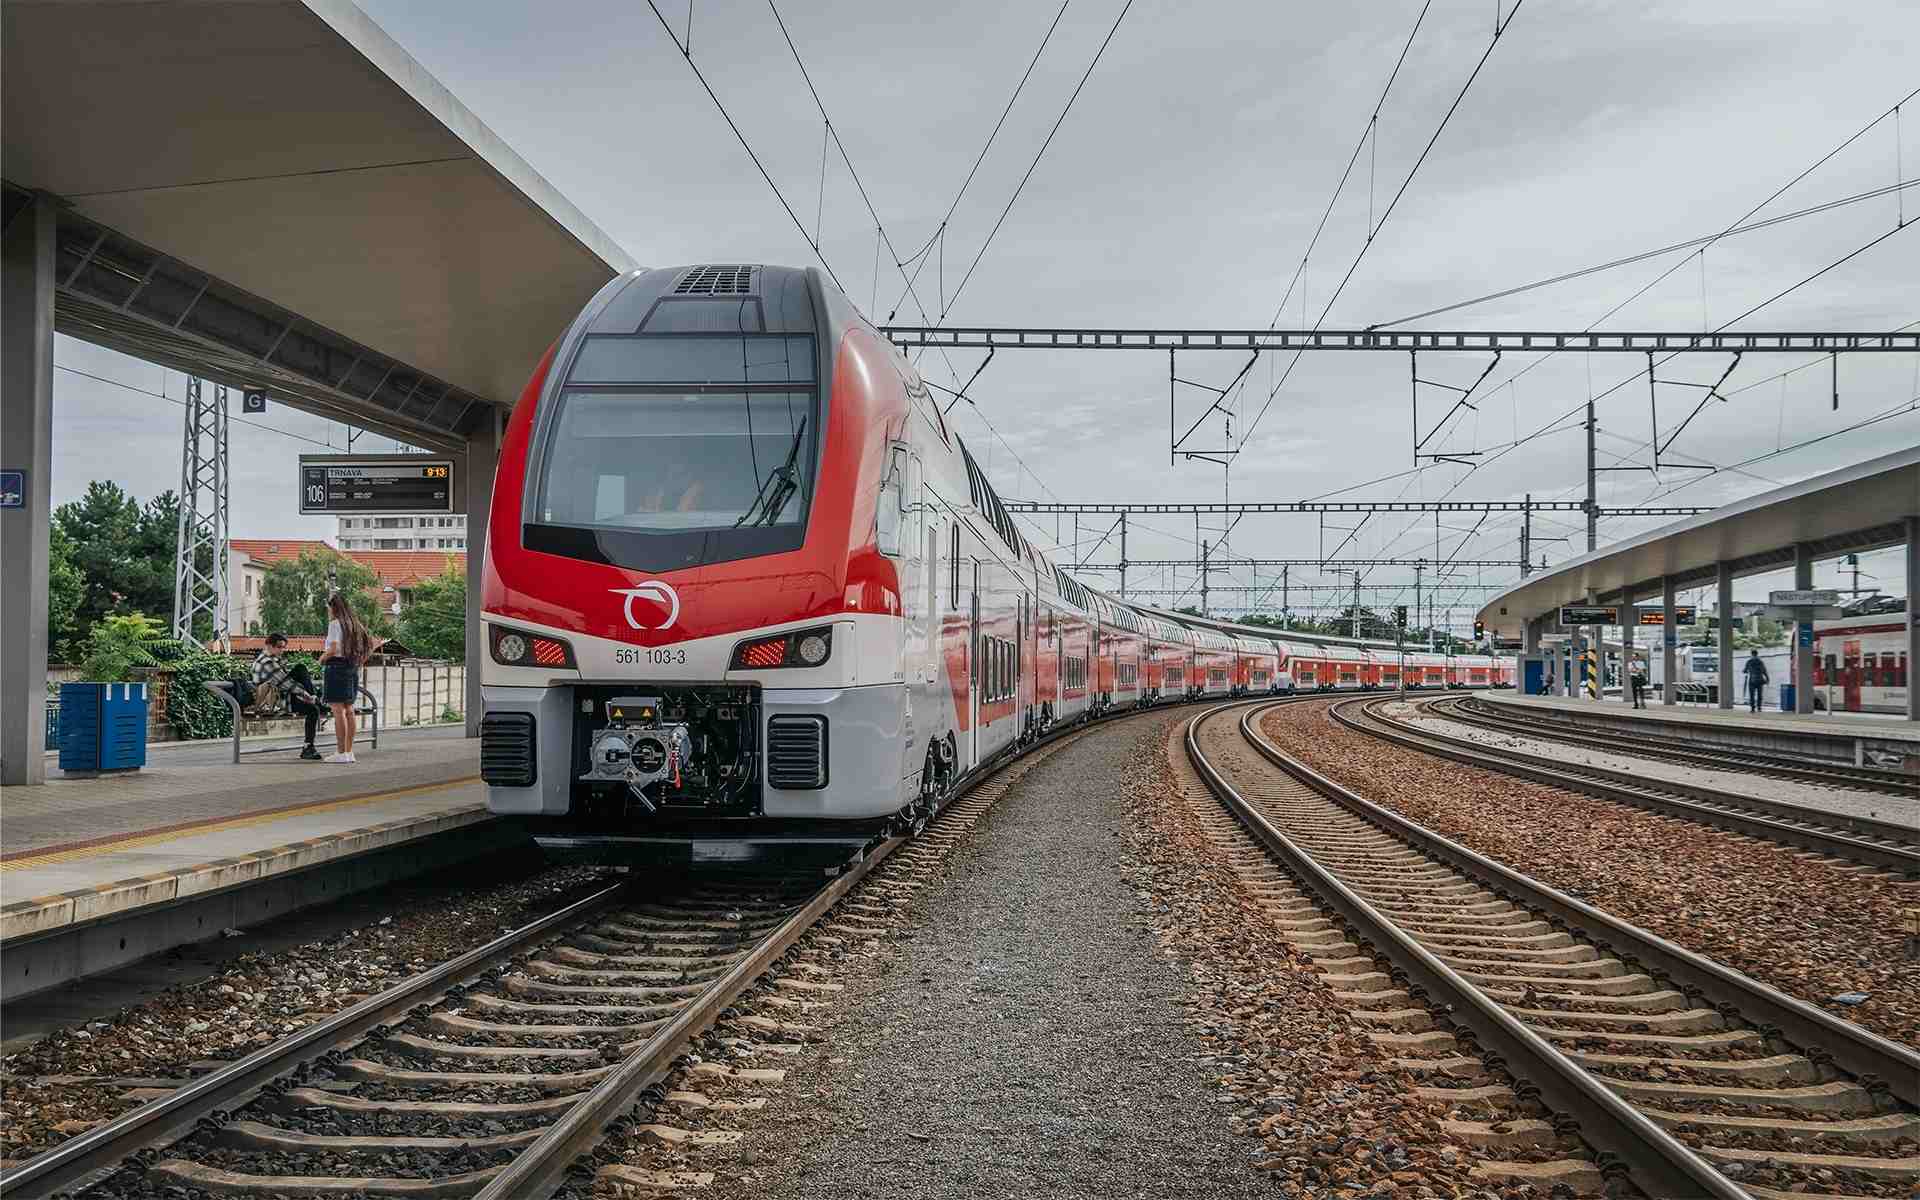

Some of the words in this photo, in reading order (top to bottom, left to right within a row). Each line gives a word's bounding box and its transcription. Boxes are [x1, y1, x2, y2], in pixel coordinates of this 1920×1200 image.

[248, 394, 261, 408] G
[328, 468, 363, 478] TRNAVA
[306, 485, 324, 503] 106
[616, 649, 640, 664] 561
[646, 649, 686, 664] 103-3
